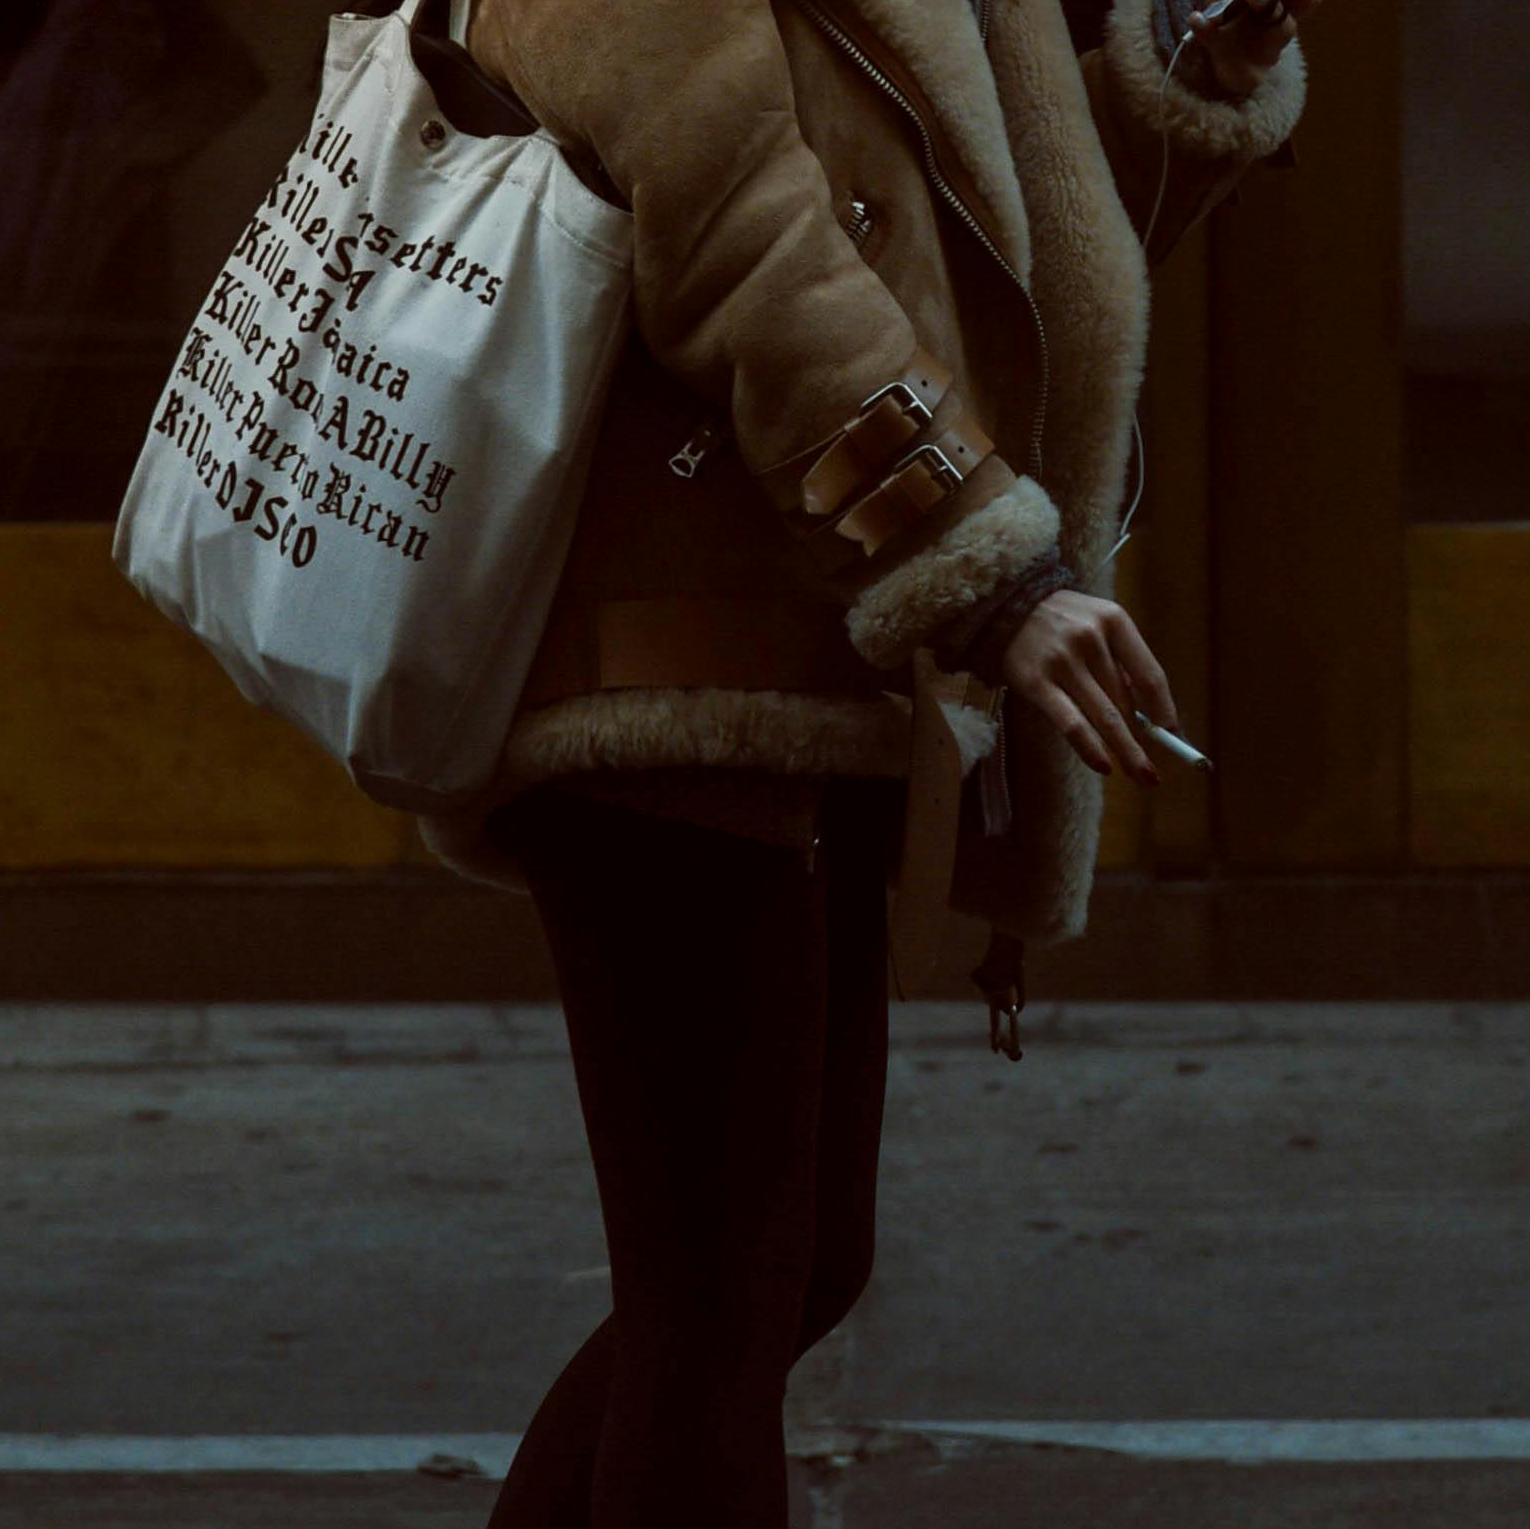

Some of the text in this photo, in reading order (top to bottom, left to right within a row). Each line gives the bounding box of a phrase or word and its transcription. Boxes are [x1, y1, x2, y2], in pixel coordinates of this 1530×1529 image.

[205, 270, 276, 365] Killer
[233, 217, 410, 402] Killer Jaaica
[154, 388, 222, 489] Killer
[176, 327, 244, 424] Killer
[315, 461, 430, 562] Rican
